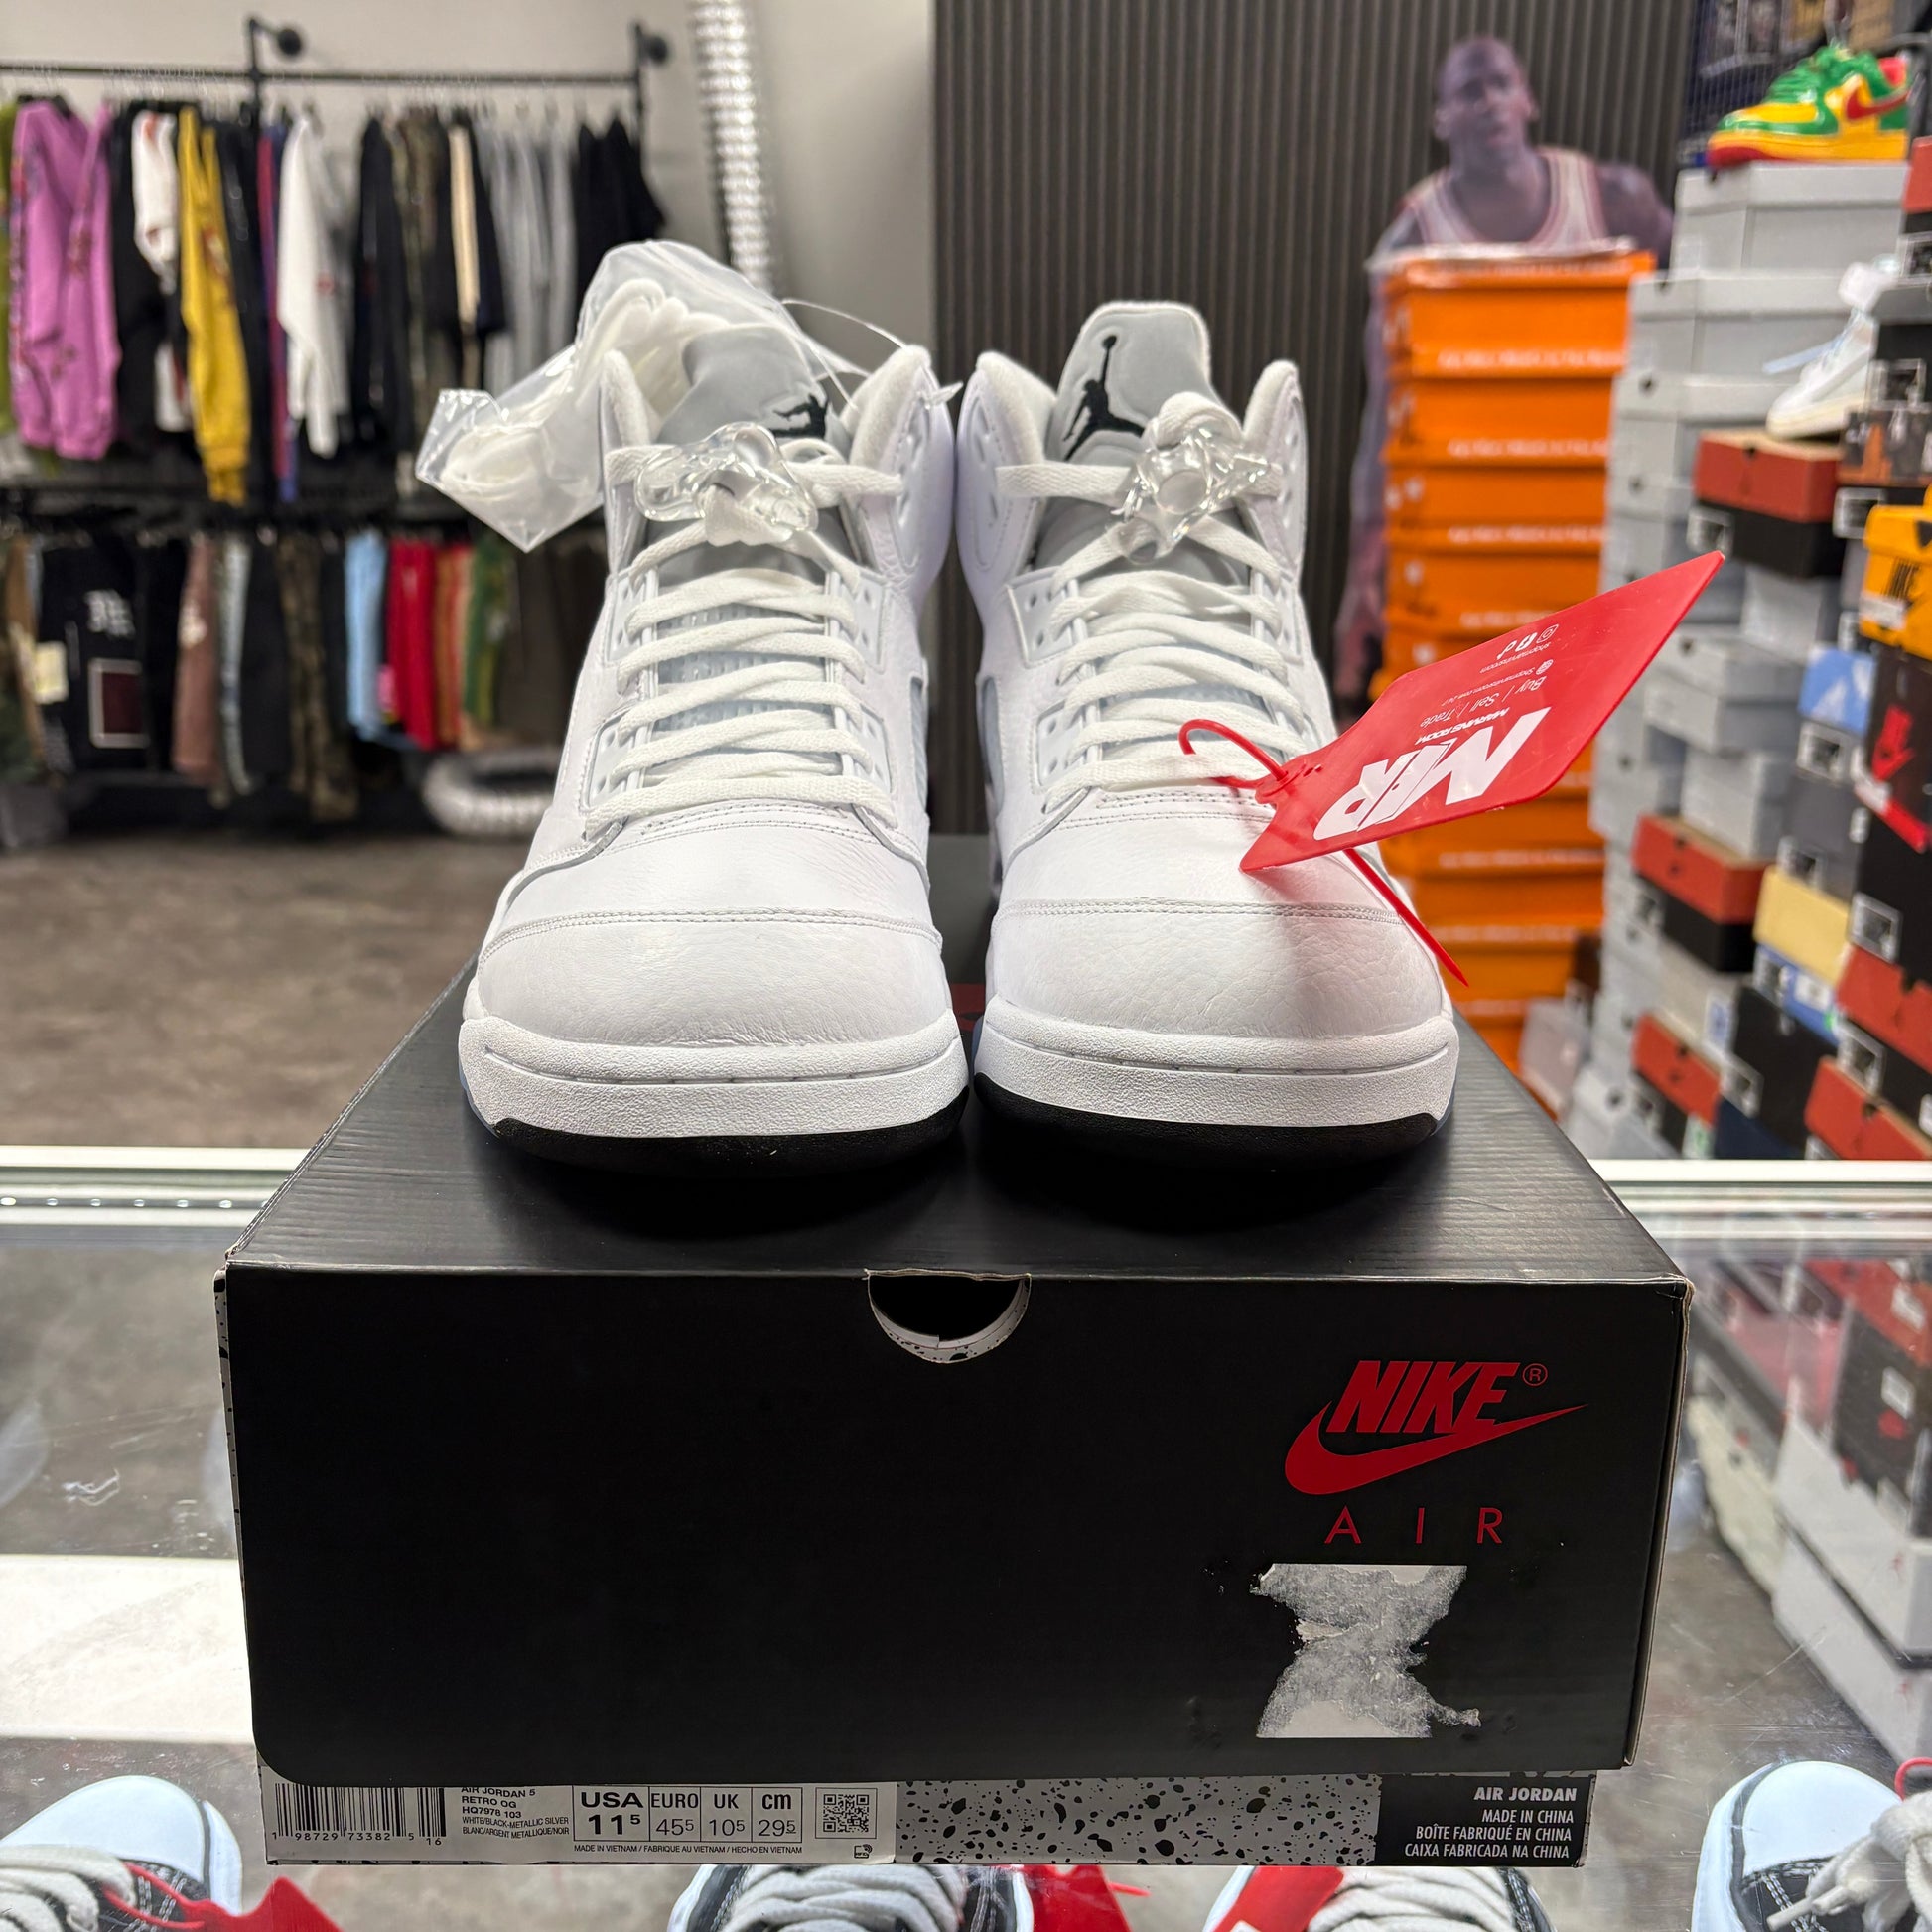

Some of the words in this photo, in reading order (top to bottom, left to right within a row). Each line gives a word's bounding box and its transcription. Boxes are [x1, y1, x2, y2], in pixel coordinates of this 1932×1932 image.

[1515, 676, 1547, 694] Buy
[1469, 692, 1500, 713] Sell
[1420, 708, 1456, 728] Trade
[1414, 726, 1453, 746] ROOM
[1326, 1360, 1520, 1434] NIKE
[1324, 1505, 1503, 1544] AIR
[462, 1796, 497, 1806] RETRO
[482, 1788, 526, 1798] JORDAN
[581, 1791, 643, 1808] USA
[651, 1792, 699, 1808] EURO
[714, 1793, 739, 1808] UK
[1474, 1787, 1503, 1801] AIR
[1508, 1787, 1577, 1802] JORDAN
[761, 1793, 791, 1810] cm
[462, 1806, 501, 1817] HQ7978
[1482, 1809, 1518, 1823] MADE
[1520, 1809, 1533, 1823] IN
[1537, 1810, 1574, 1824] CHINA
[545, 1816, 569, 1825] SILVER
[295, 1832, 339, 1841] 98729
[347, 1832, 391, 1841] 73382
[408, 1832, 415, 1841] 5
[463, 1827, 509, 1839] BLANC/ARGENT
[1416, 1823, 1450, 1840] BOÎTE
[1453, 1825, 1513, 1841] FABRIQUÉ
[1516, 1827, 1531, 1841] EN
[1535, 1828, 1572, 1841] CHINA
[1405, 1843, 1440, 1857] CAIXA
[1443, 1844, 1508, 1858] FABRICADA
[1512, 1845, 1528, 1858] NA
[1533, 1845, 1570, 1859] CHINA
